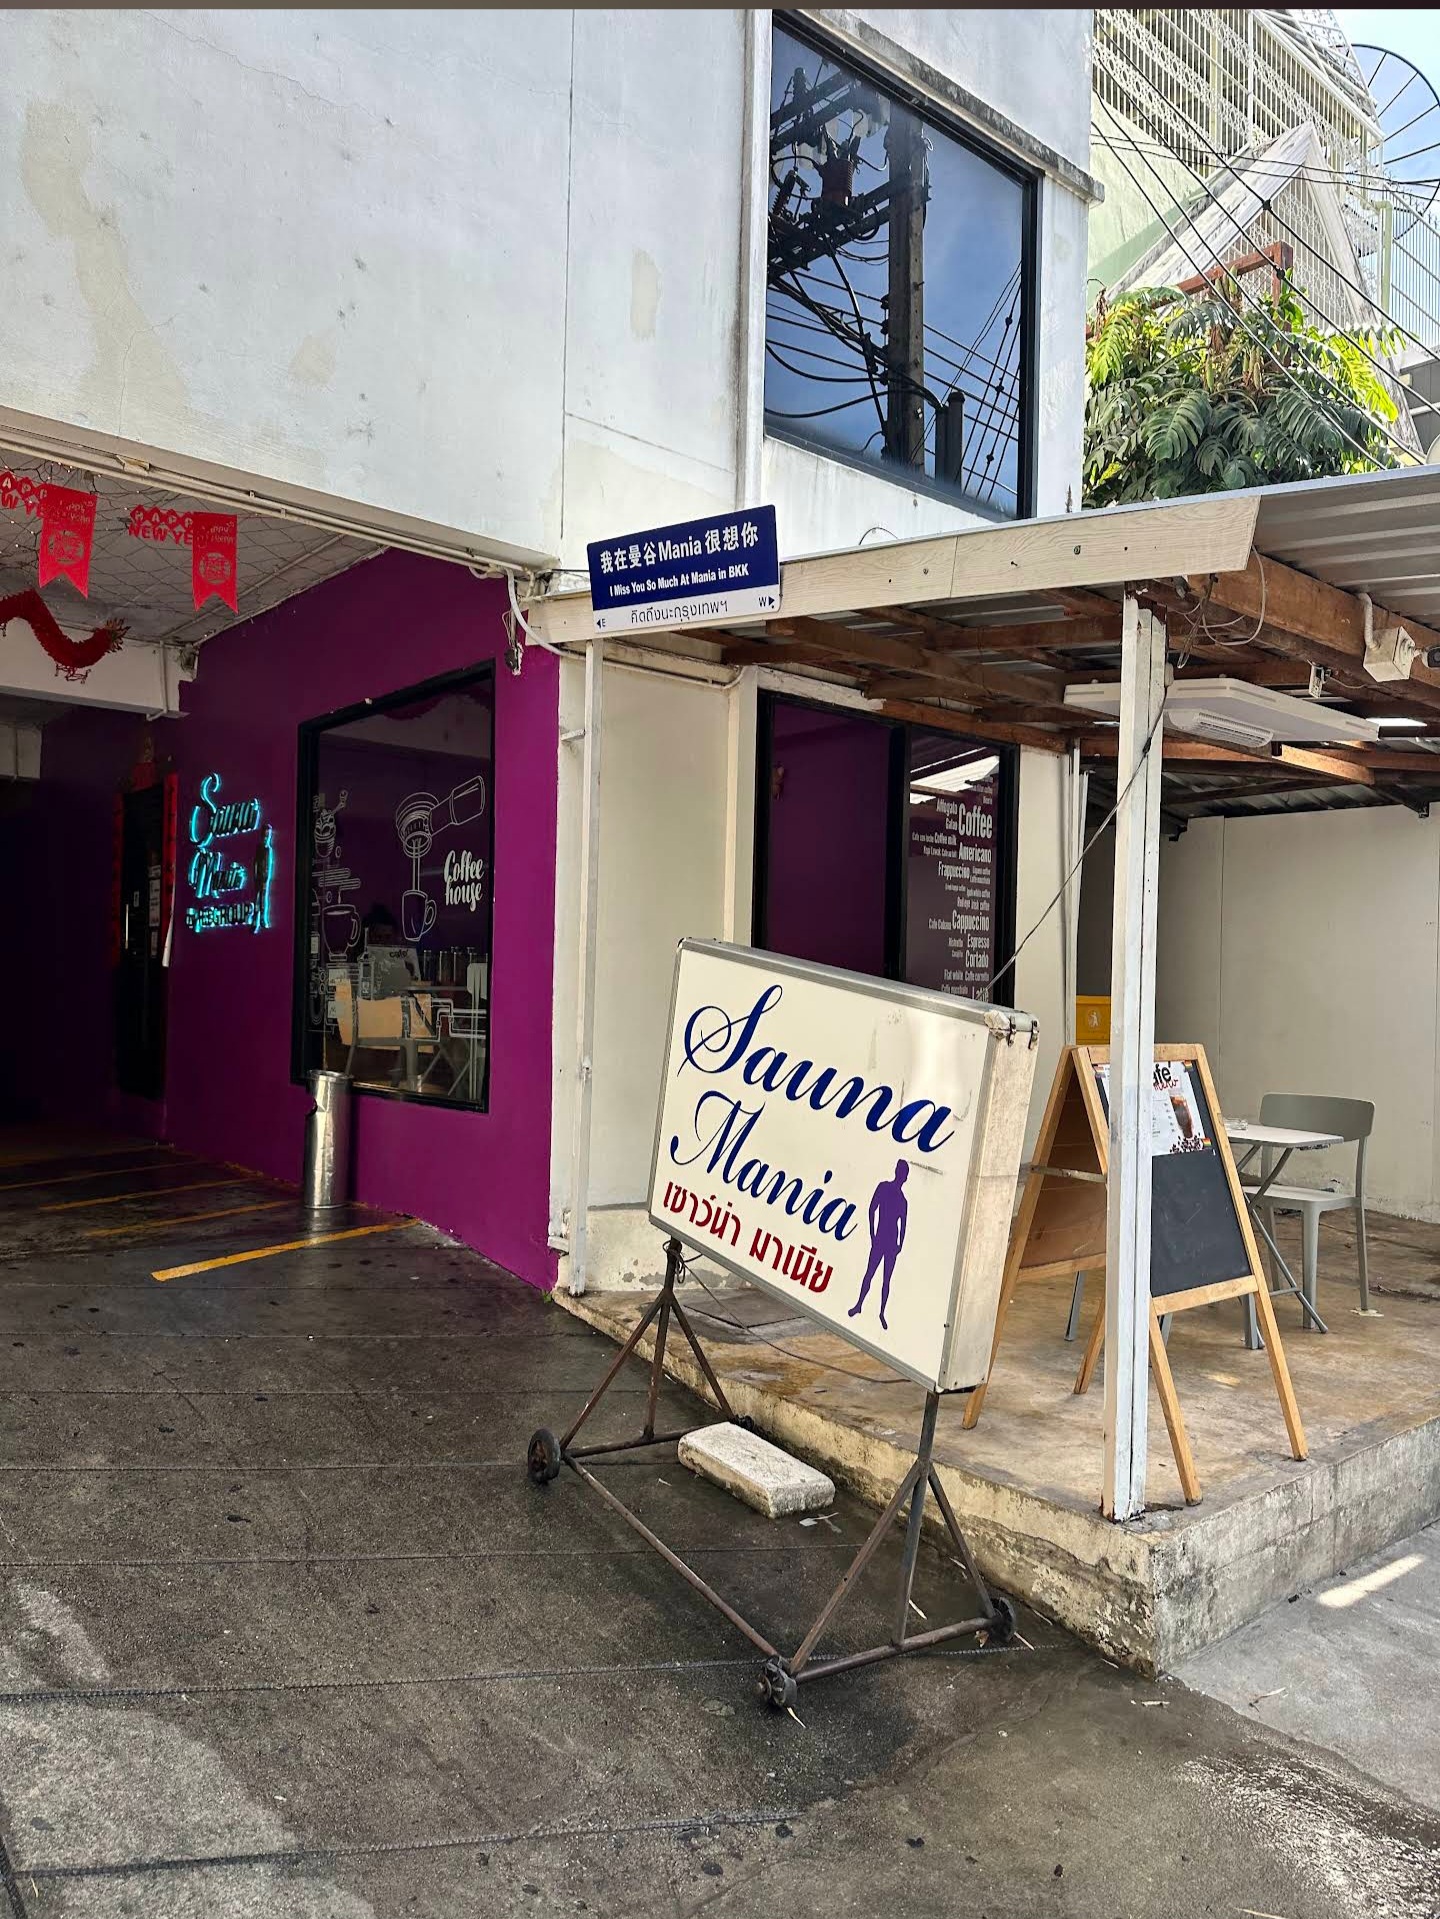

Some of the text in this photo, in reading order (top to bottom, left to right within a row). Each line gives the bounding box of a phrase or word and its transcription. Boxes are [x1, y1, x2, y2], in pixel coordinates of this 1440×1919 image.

[128, 523, 169, 541] NEW
[609, 563, 749, 597] I Miss You So Much At Mania in BKK
[759, 596, 767, 607] W
[958, 802, 993, 839] Coffee
[443, 850, 485, 883] Coffee
[958, 842, 992, 863] Americano
[938, 860, 971, 880] Frappuccino
[445, 875, 484, 912] house
[952, 909, 990, 934] Cappuccino
[967, 933, 990, 951] Espresso
[965, 949, 989, 968] Cortado
[677, 984, 955, 1153] Sauna
[670, 1090, 858, 1241] Mania
[663, 1181, 834, 1293] เซาว์น่า มาเนีย
